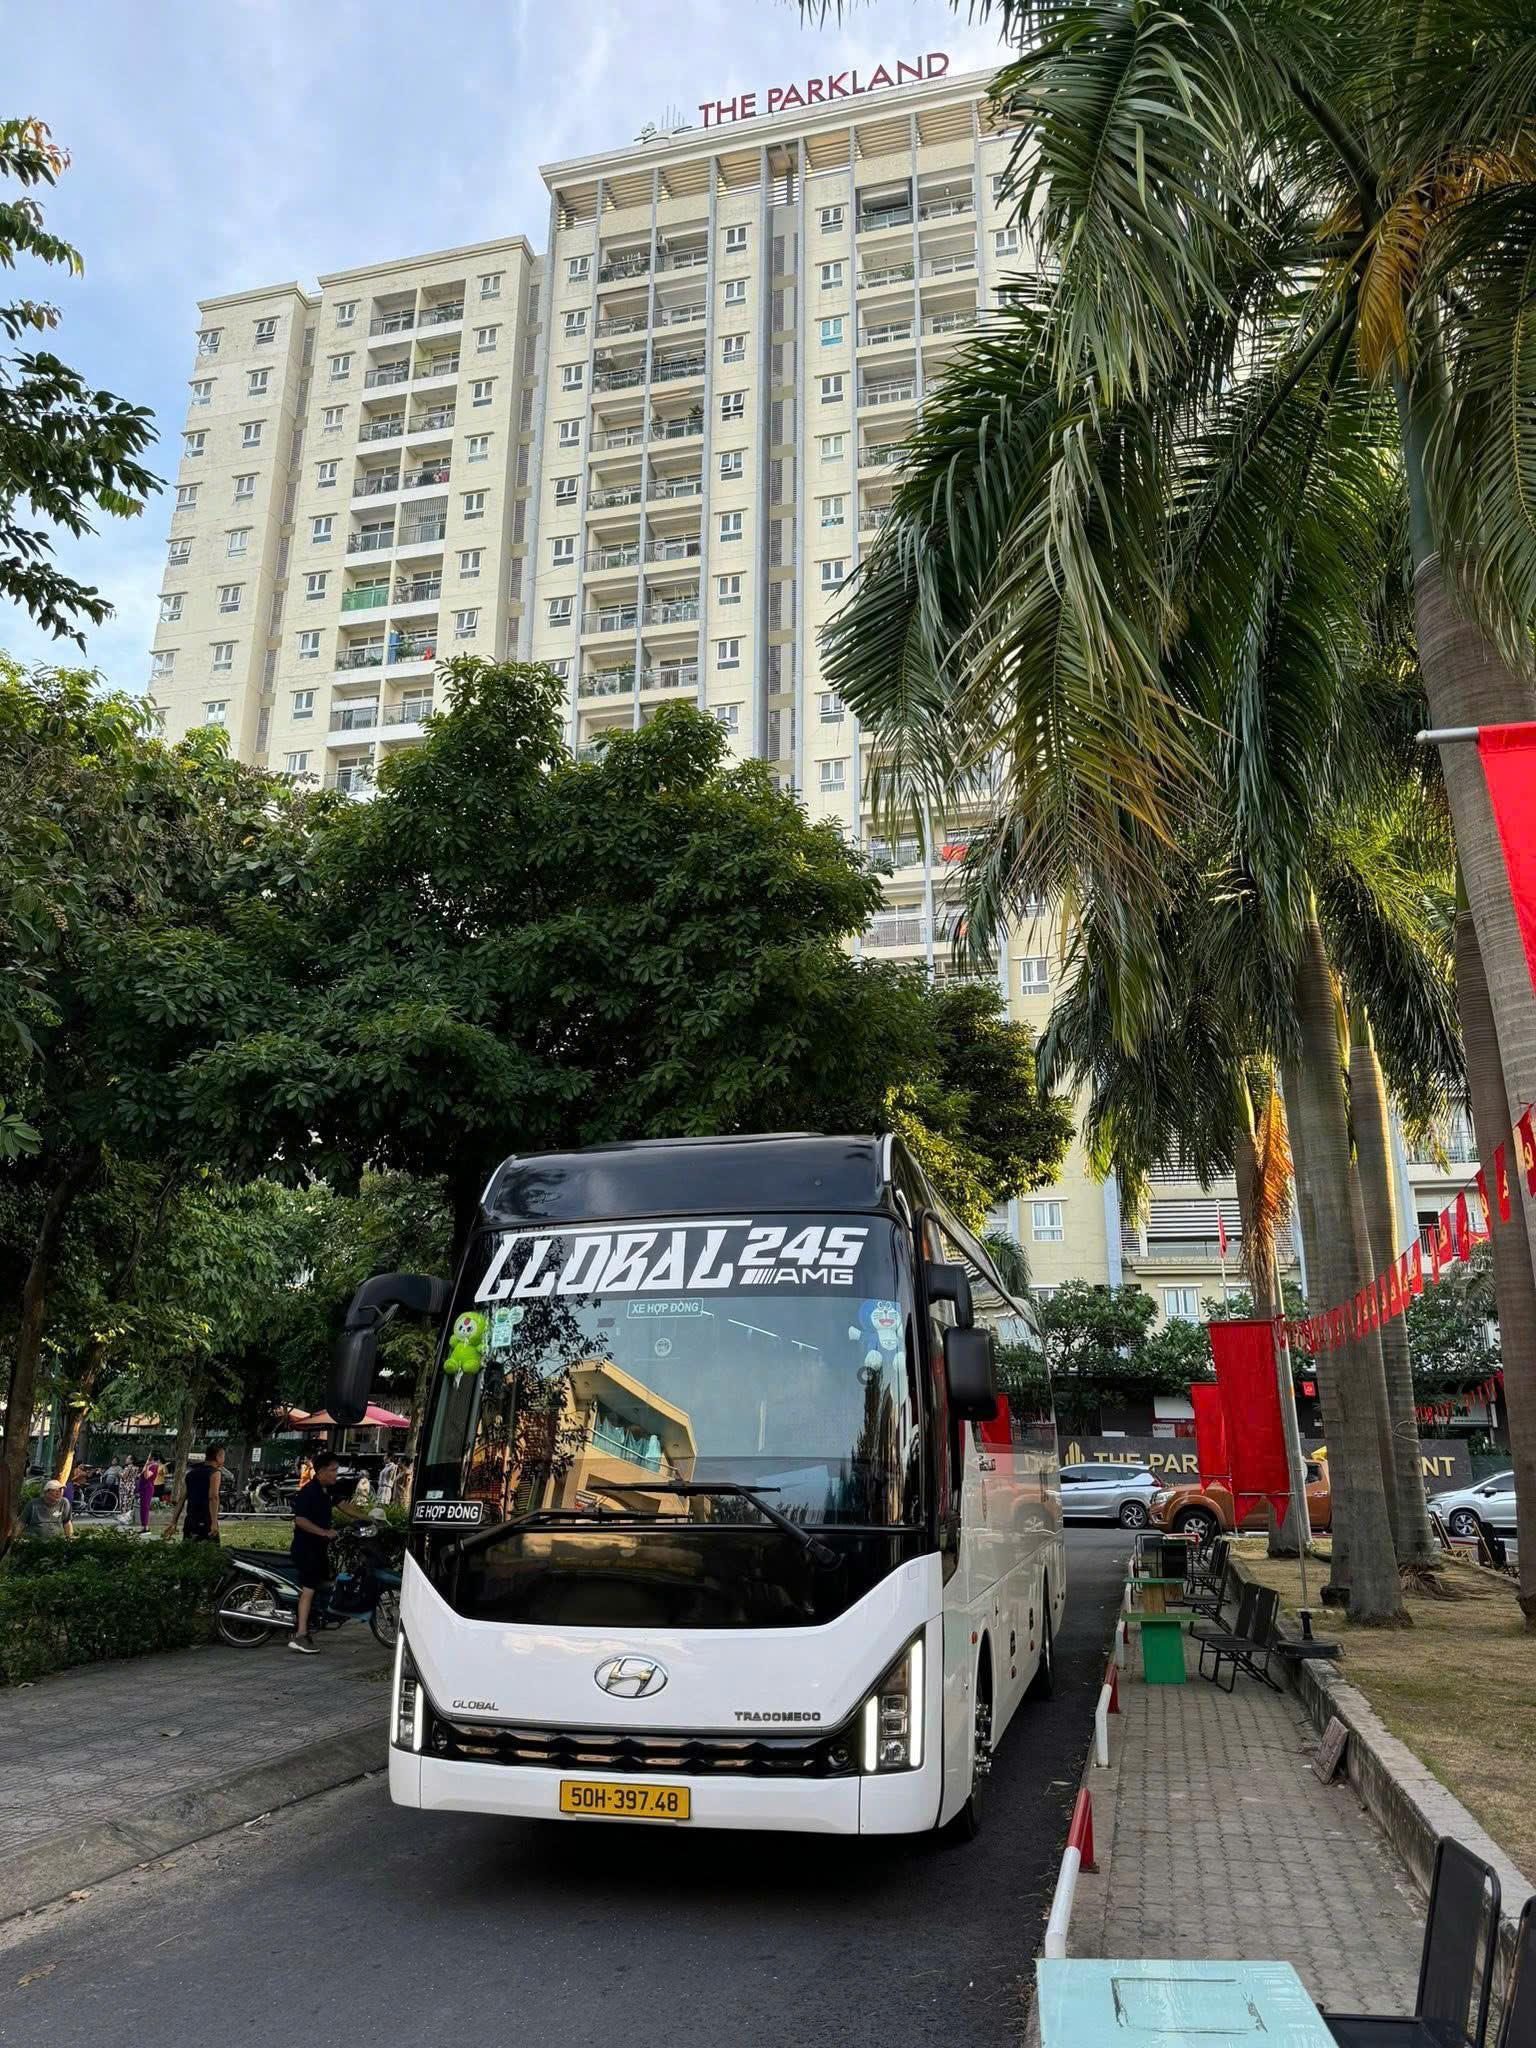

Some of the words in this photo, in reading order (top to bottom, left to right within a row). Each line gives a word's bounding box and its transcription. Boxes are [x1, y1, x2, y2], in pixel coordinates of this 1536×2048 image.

[698, 93, 757, 128] THE
[767, 52, 950, 113] PARKLAND
[773, 1268, 854, 1285] AMG
[631, 1303, 646, 1314] XE
[1150, 1454, 1199, 1474] PAR
[415, 1505, 426, 1518] XE
[452, 1699, 499, 1711] GLOBAL
[571, 1787, 678, 1812] 50H-397.48
